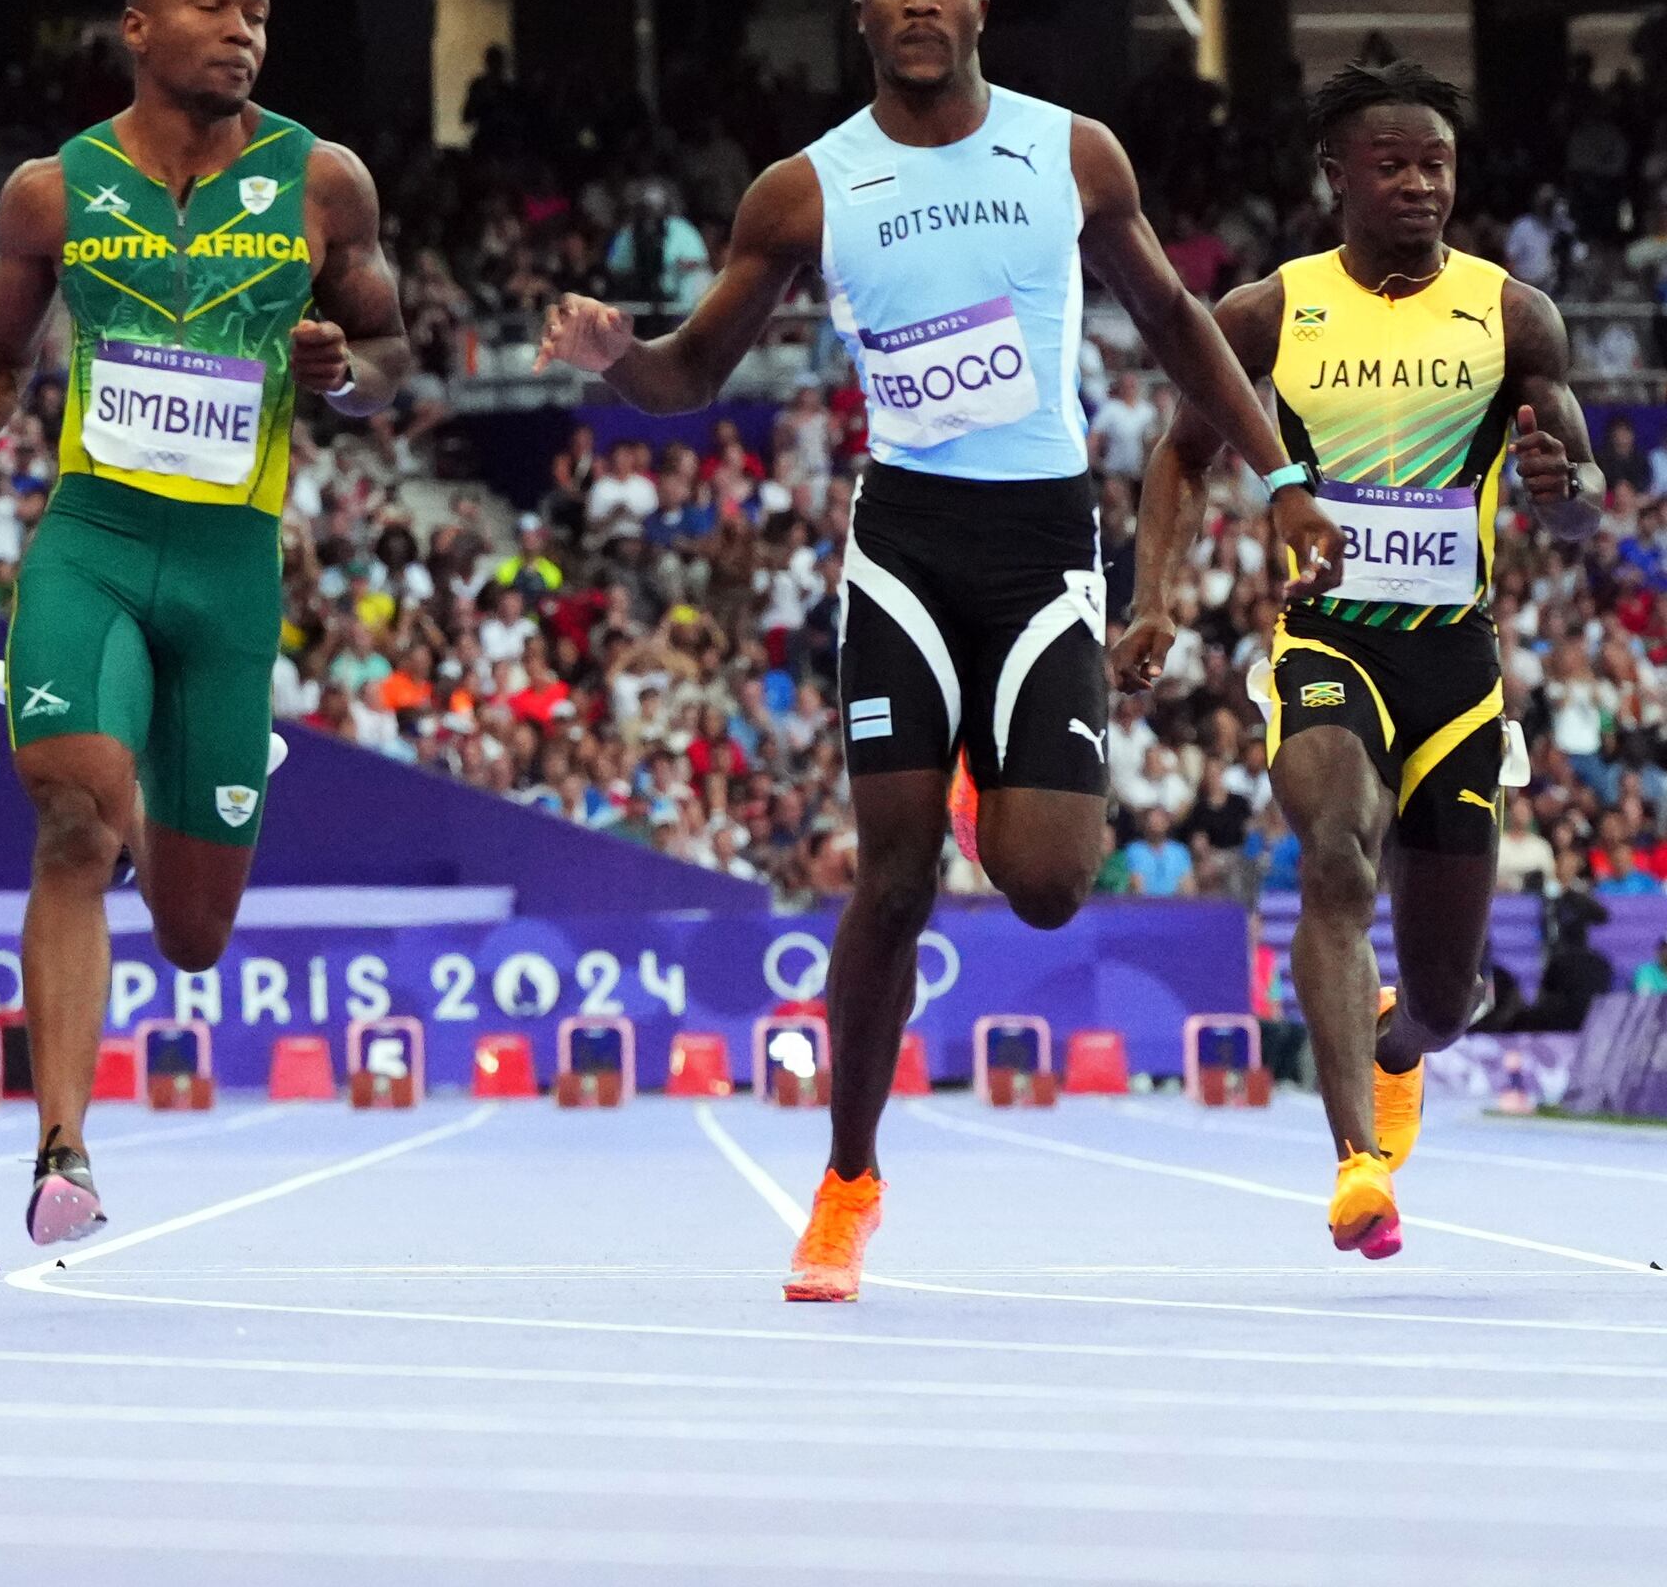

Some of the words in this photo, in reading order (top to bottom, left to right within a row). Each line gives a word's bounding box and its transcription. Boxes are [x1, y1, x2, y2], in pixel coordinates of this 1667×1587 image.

[878, 200, 1030, 247] BOTSWANA
[63, 235, 167, 266] SOUTH
[188, 233, 311, 264] AFRICA
[880, 326, 925, 349] PARIS
[929, 314, 969, 336] 2024
[132, 349, 178, 366] PARIS
[183, 355, 223, 372] 2024
[871, 344, 1022, 408] TEBOGO
[1310, 359, 1473, 390] JAMAICA
[98, 386, 254, 443] SIMBINE
[1356, 488, 1400, 501] PARIS
[1404, 490, 1444, 504] 2024
[1340, 525, 1459, 566] BLAKE
[111, 955, 391, 1026] PARIS
[430, 949, 687, 1021] 2024
